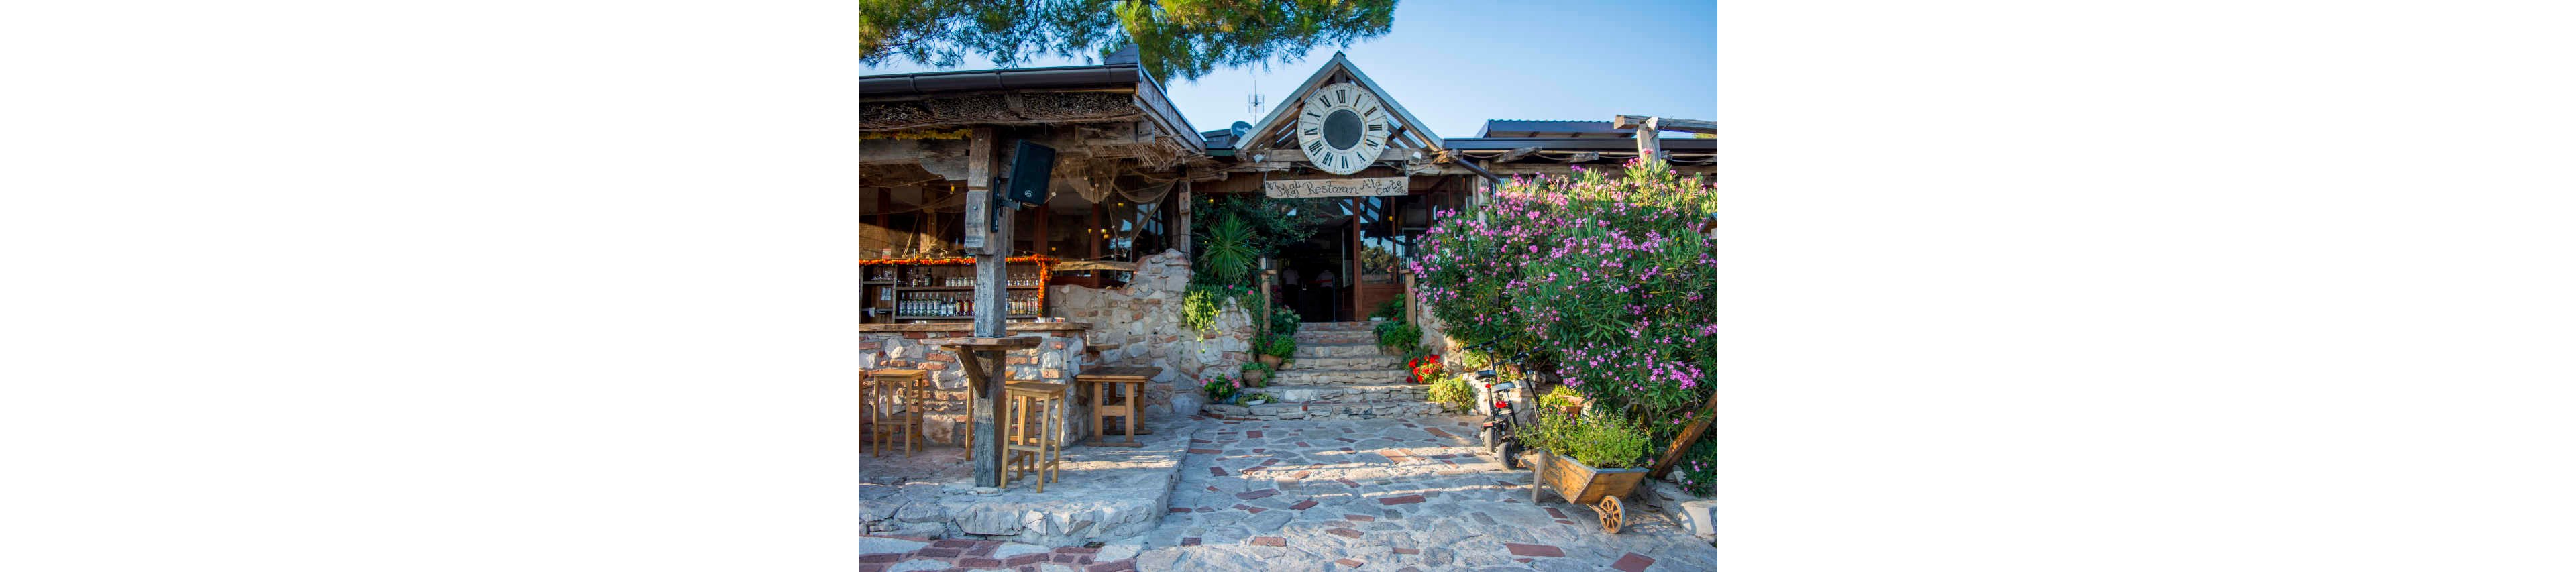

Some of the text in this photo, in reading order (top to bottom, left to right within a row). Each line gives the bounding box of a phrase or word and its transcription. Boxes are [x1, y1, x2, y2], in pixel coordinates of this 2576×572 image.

[1319, 95, 1331, 110] XI
[1336, 89, 1346, 103] XII
[1354, 93, 1362, 107] I
[1307, 110, 1321, 121] X
[1364, 106, 1377, 117] II
[1304, 127, 1318, 135] IX
[1308, 140, 1324, 156] VIII
[1365, 139, 1379, 150] IV
[1322, 152, 1334, 166] VII
[1342, 156, 1348, 168] VI
[1356, 152, 1366, 164] V
[1306, 180, 1359, 195] Restoran
[1375, 180, 1401, 195] Carte
